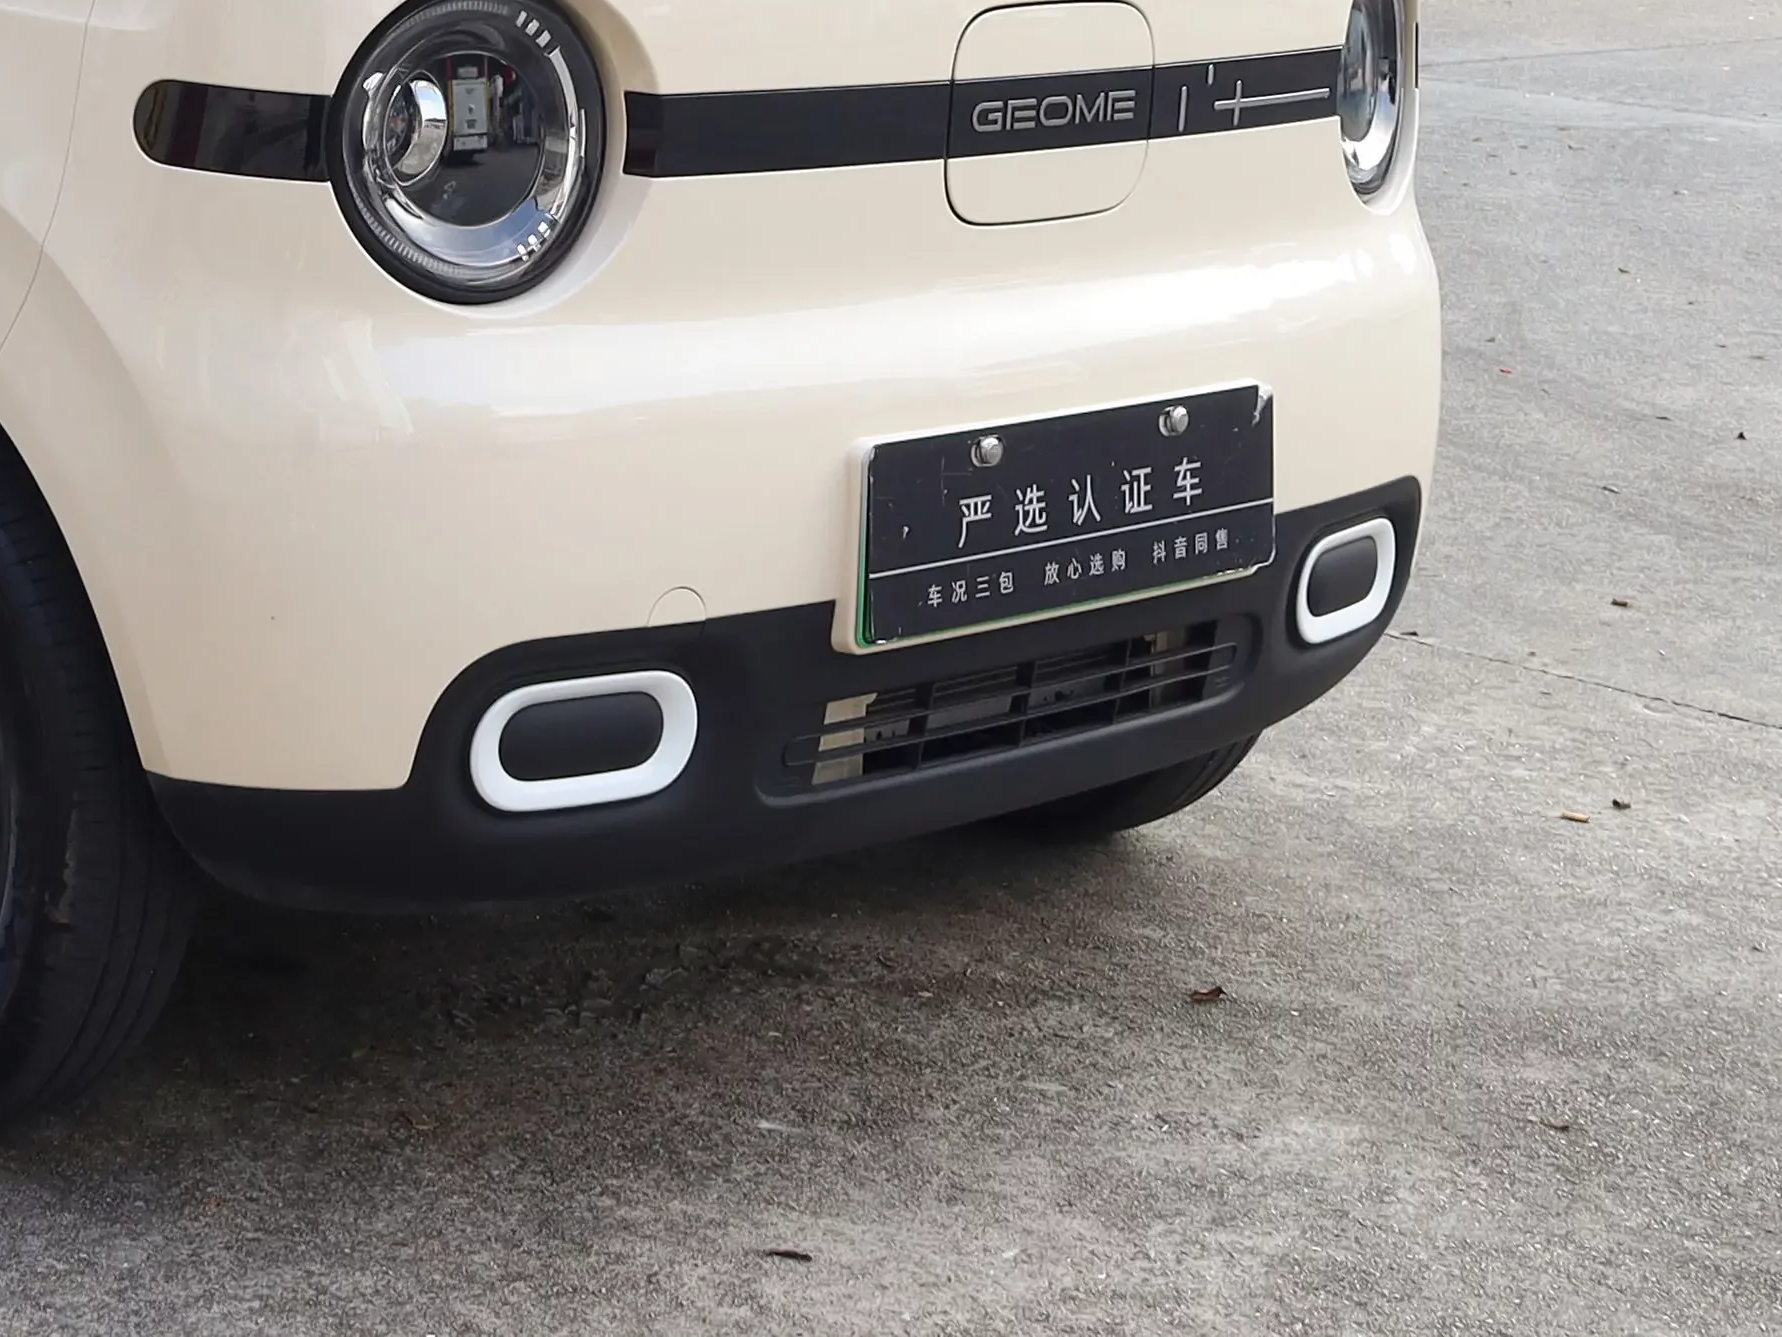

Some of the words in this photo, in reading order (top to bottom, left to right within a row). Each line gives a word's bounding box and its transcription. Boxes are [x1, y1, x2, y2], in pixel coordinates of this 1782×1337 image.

[972, 89, 1136, 133] GEOME
[958, 457, 1203, 549] 严选认证车
[926, 571, 1014, 607] 车况三包
[1044, 550, 1127, 585] 放心选购
[1152, 528, 1229, 563] 抖音同售
